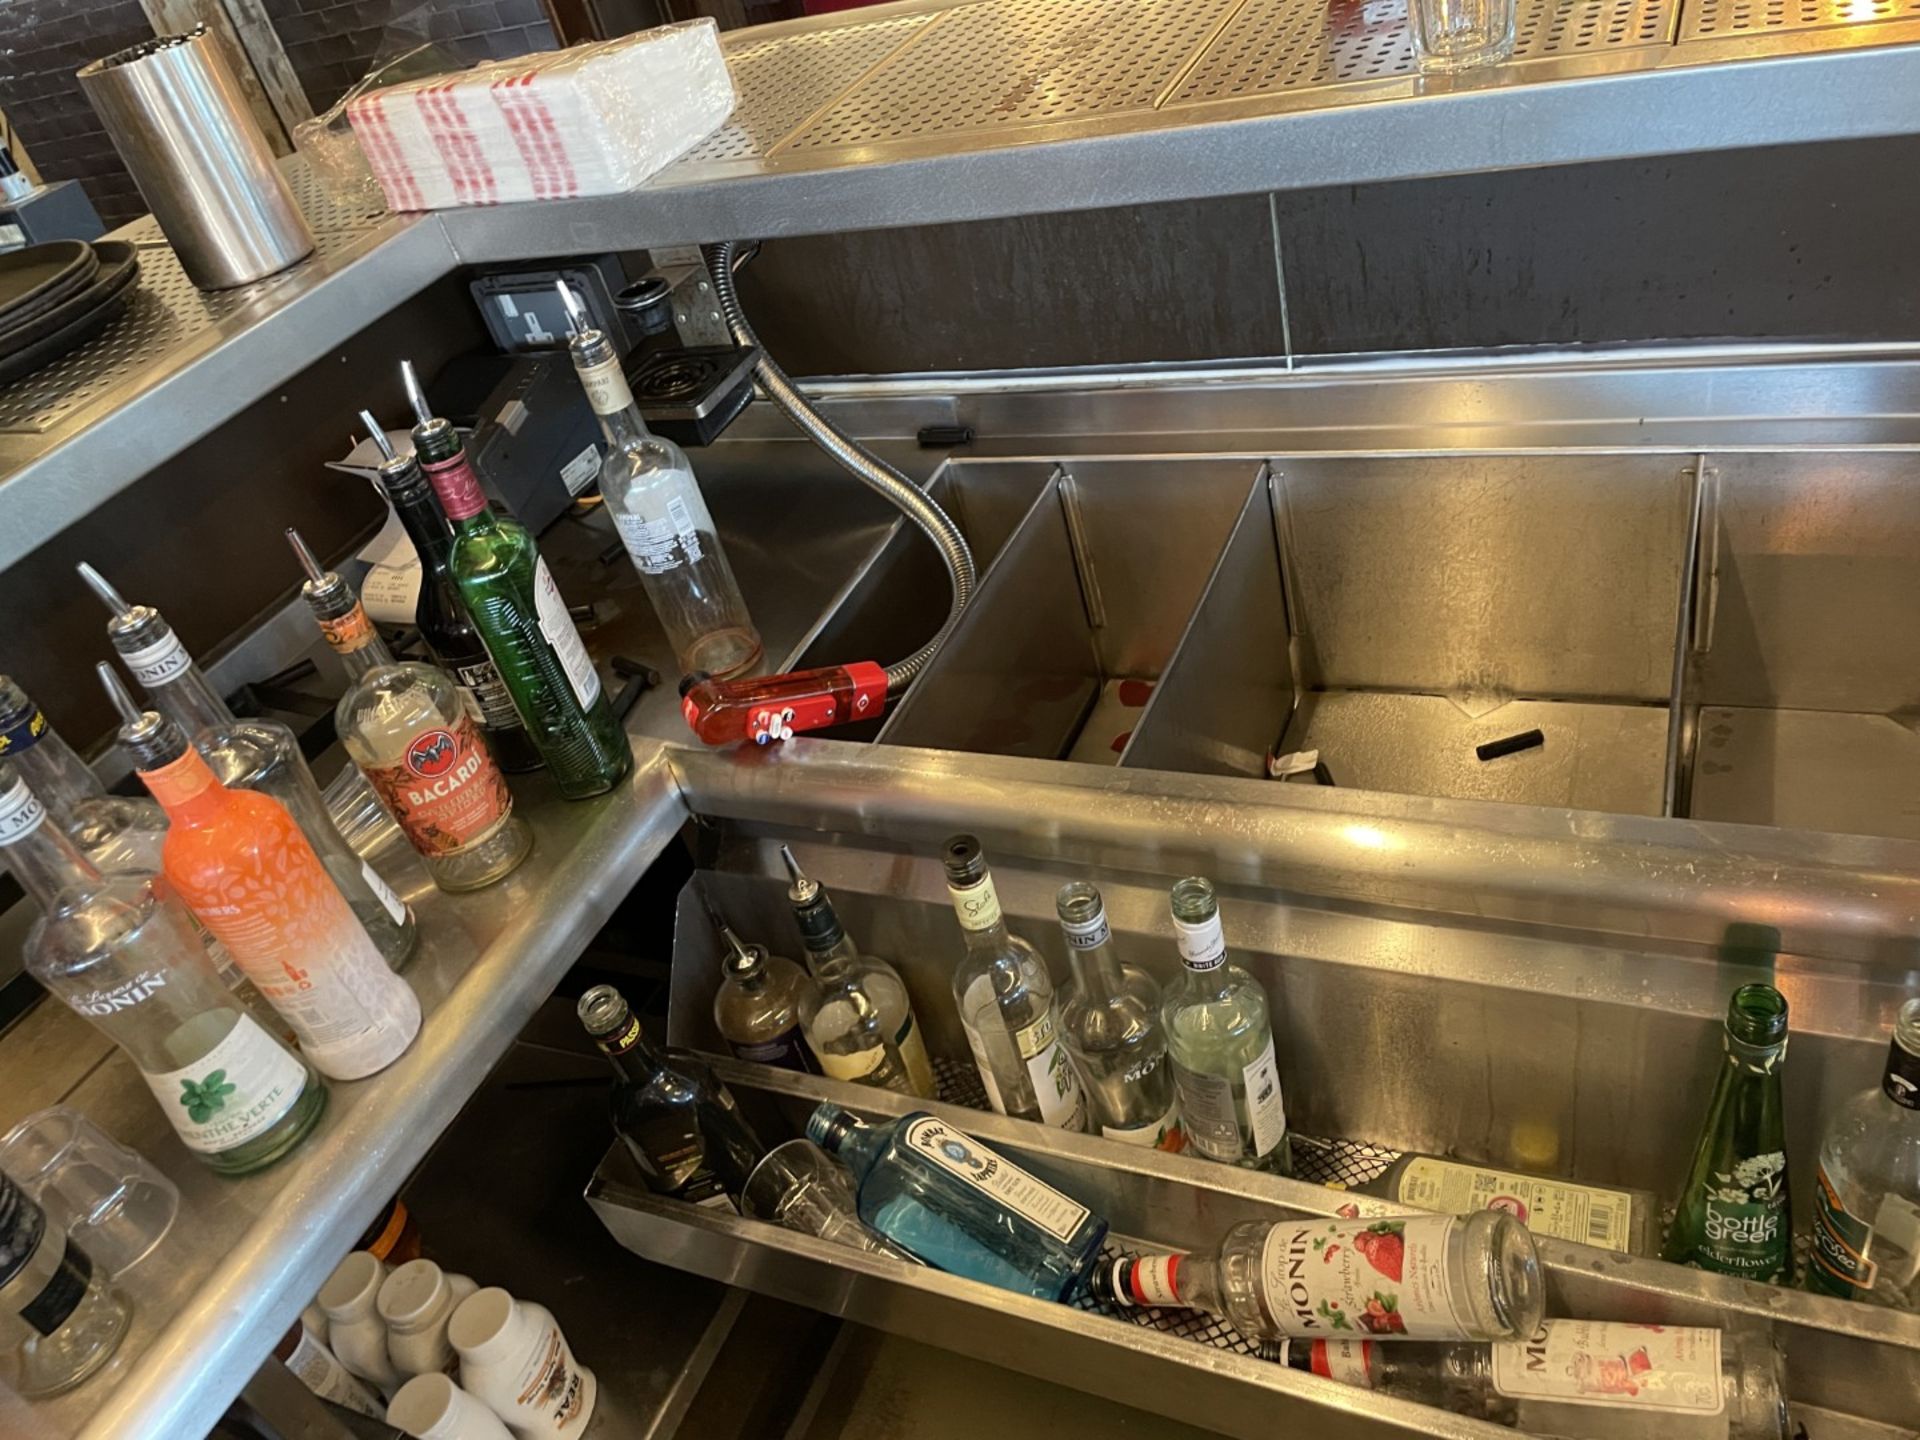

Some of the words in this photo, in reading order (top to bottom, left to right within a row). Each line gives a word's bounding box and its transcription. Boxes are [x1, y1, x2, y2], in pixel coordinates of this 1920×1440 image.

[407, 746, 482, 806] BACARDÍ
[240, 1086, 284, 1125] VERTE
[921, 1126, 947, 1149] BOMBAY
[1705, 1219, 1777, 1244] green
[1706, 1202, 1778, 1233] bottle
[1698, 1244, 1778, 1268] elderflower
[1288, 1229, 1320, 1330] MONIN
[1336, 1245, 1360, 1310] Strawberry
[553, 1371, 581, 1420] REAL
